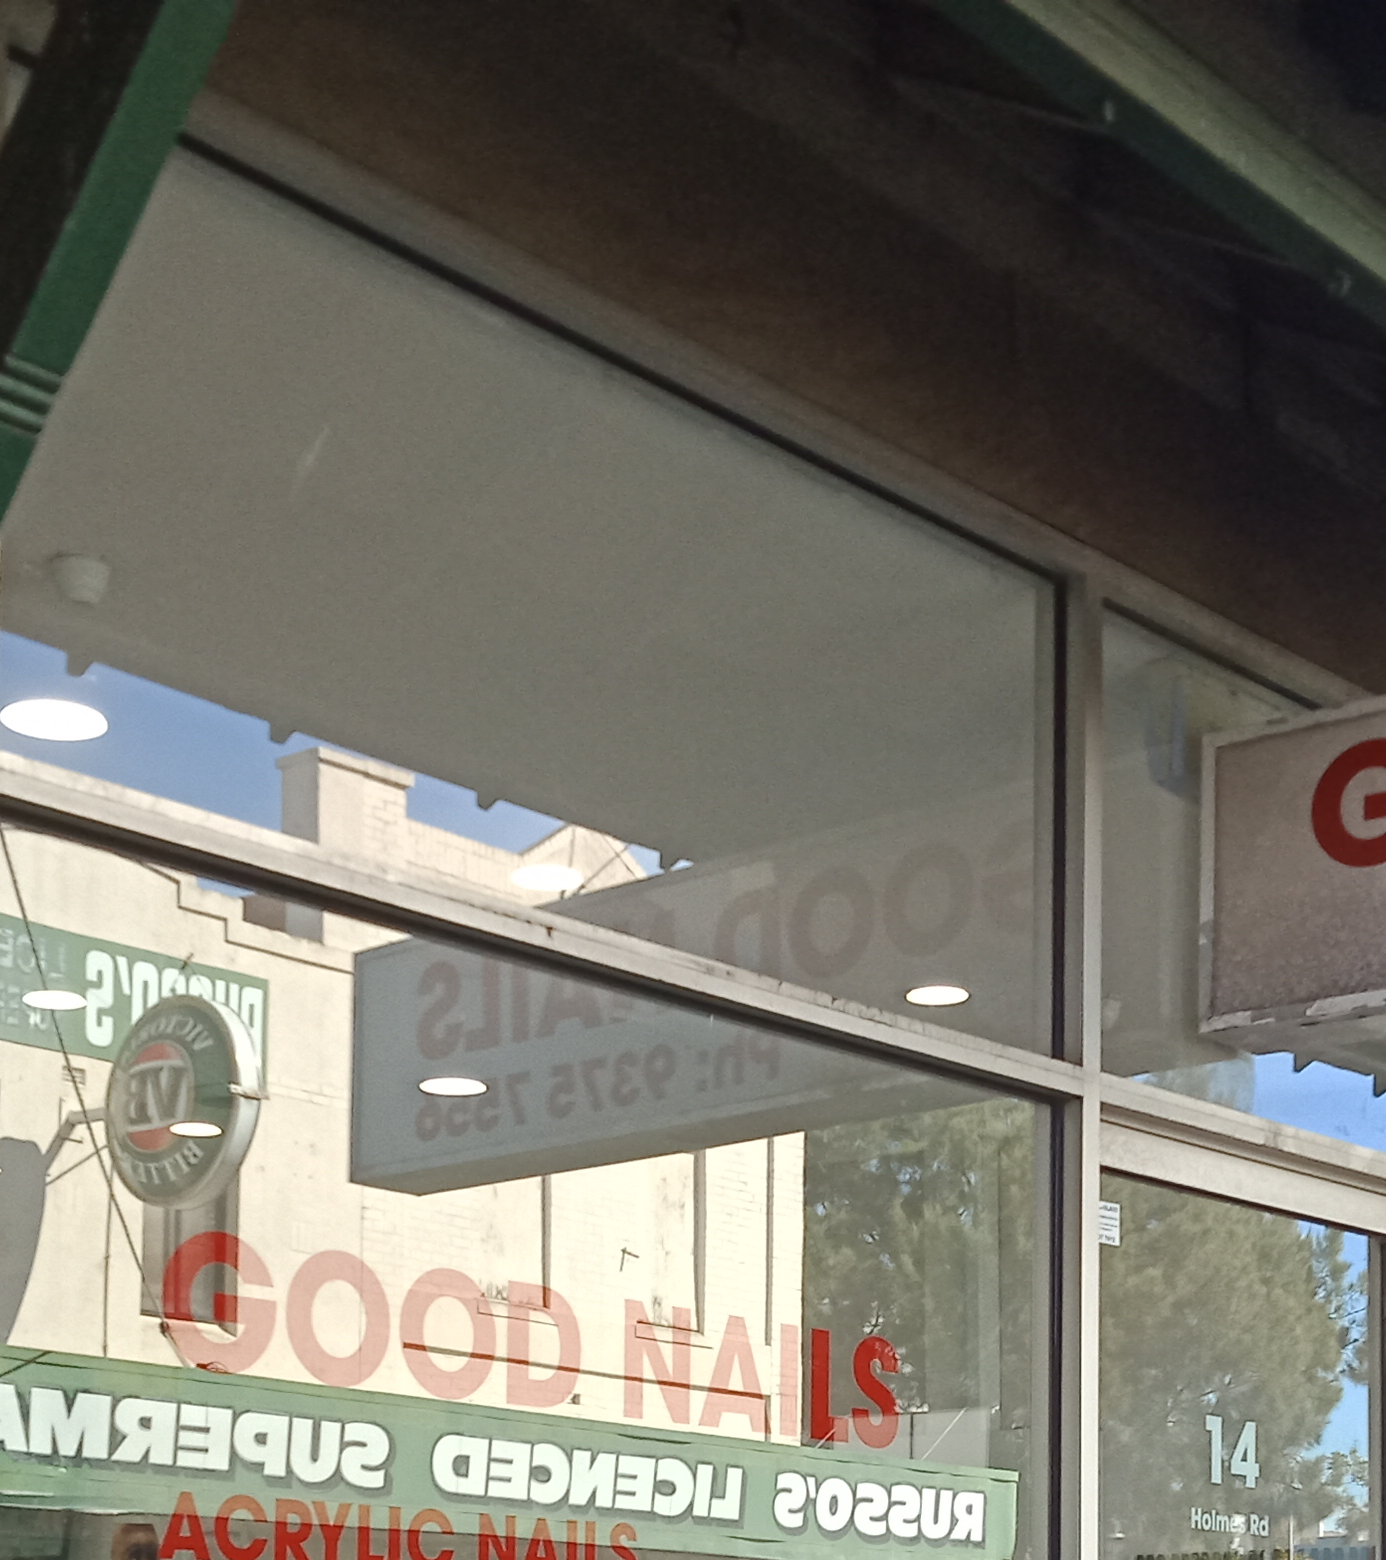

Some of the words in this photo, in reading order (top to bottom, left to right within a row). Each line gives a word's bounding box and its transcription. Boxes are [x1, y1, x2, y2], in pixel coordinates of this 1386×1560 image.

[163, 1230, 581, 1409] GOOD
[621, 1297, 901, 1448] NAILS
[1204, 1414, 1261, 1490] 14
[1190, 1506, 1246, 1535] Holmes
[1249, 1513, 1270, 1538] Rd
